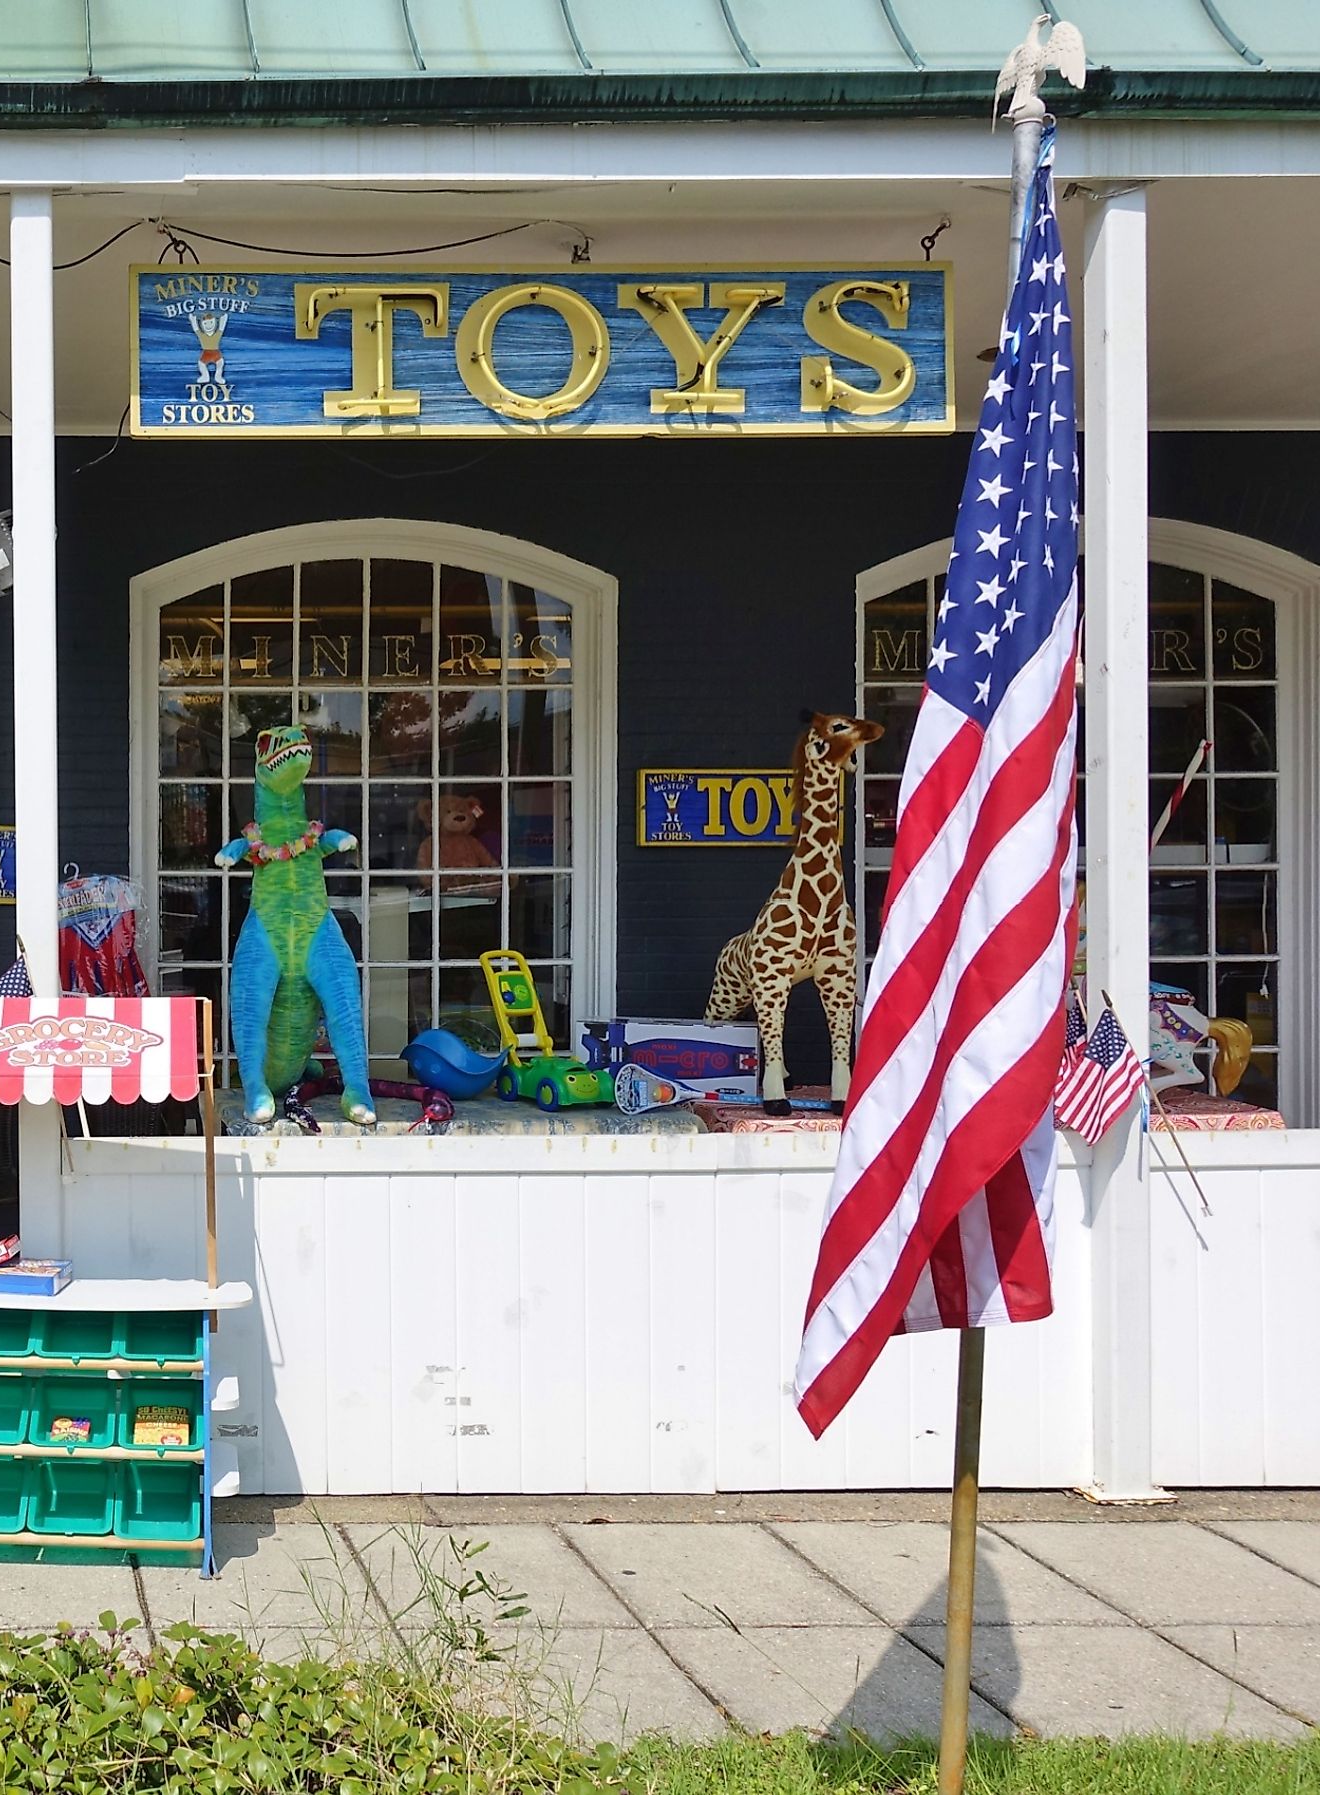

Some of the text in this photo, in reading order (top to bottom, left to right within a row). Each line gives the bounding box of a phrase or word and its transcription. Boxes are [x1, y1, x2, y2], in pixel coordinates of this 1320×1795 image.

[153, 275, 259, 302] MINER'S
[165, 297, 251, 318] BIG STUFF
[295, 281, 918, 420] TOYS
[185, 384, 235, 402] TOY
[162, 404, 255, 424] STORES
[166, 634, 559, 679] MINER'S
[649, 774, 694, 786] MINER'S
[697, 777, 796, 836] TOY
[651, 832, 692, 841] STORES
[661, 822, 683, 831] TOY
[11, 1050, 130, 1067] STORE
